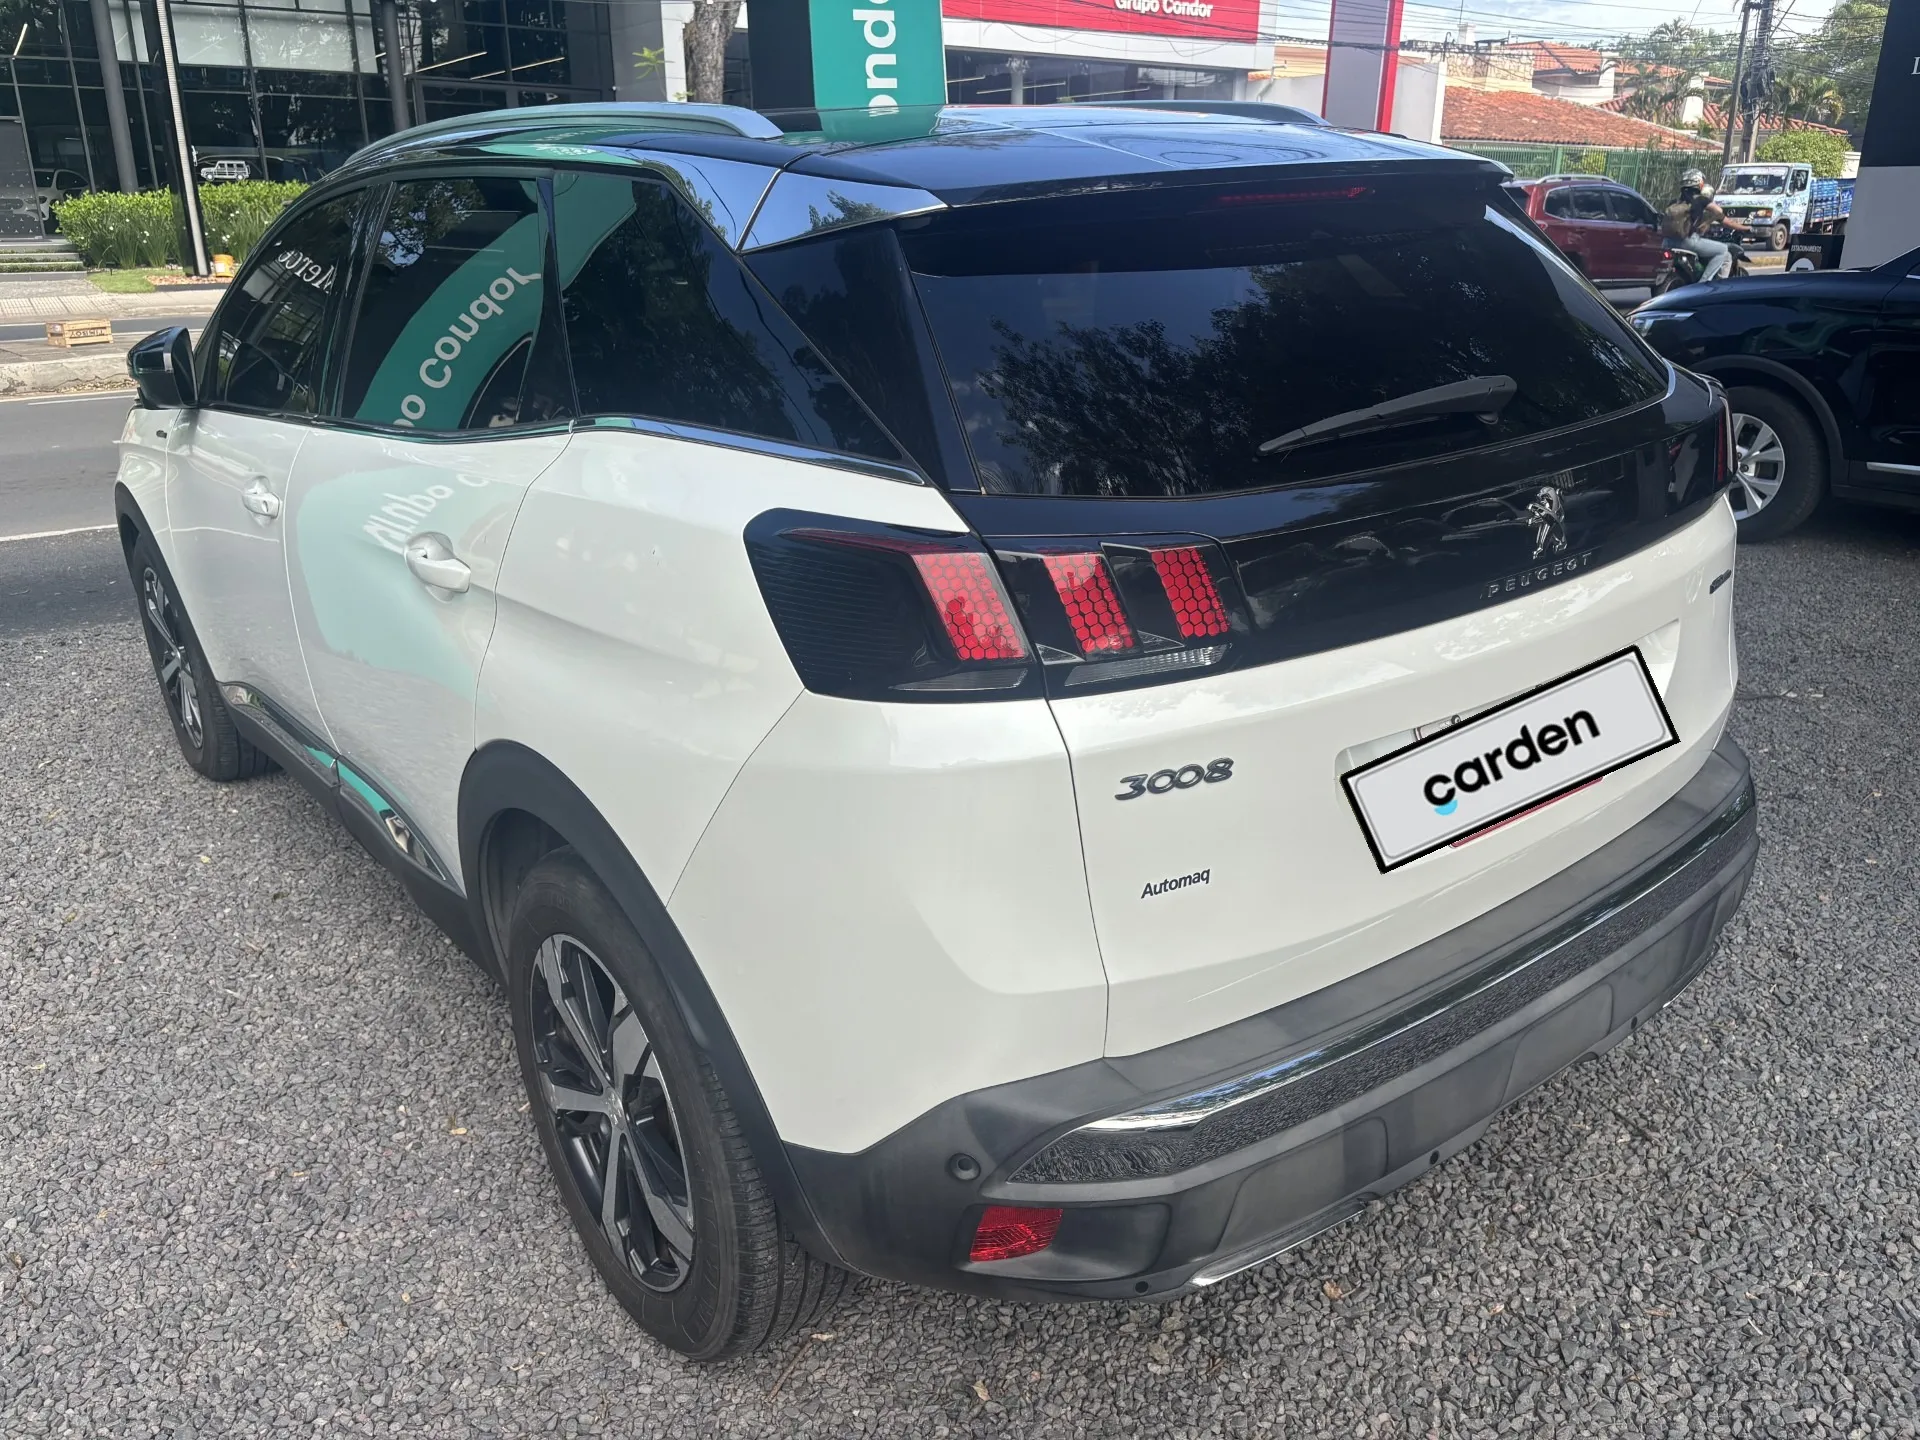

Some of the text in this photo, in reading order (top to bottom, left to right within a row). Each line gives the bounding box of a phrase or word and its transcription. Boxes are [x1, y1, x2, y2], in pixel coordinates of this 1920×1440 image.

[1115, 0, 1214, 18] Grupo Condor
[1487, 551, 1592, 598] PEUGEOT
[1114, 757, 1235, 801] 3008
[1140, 868, 1211, 900] Automaq
